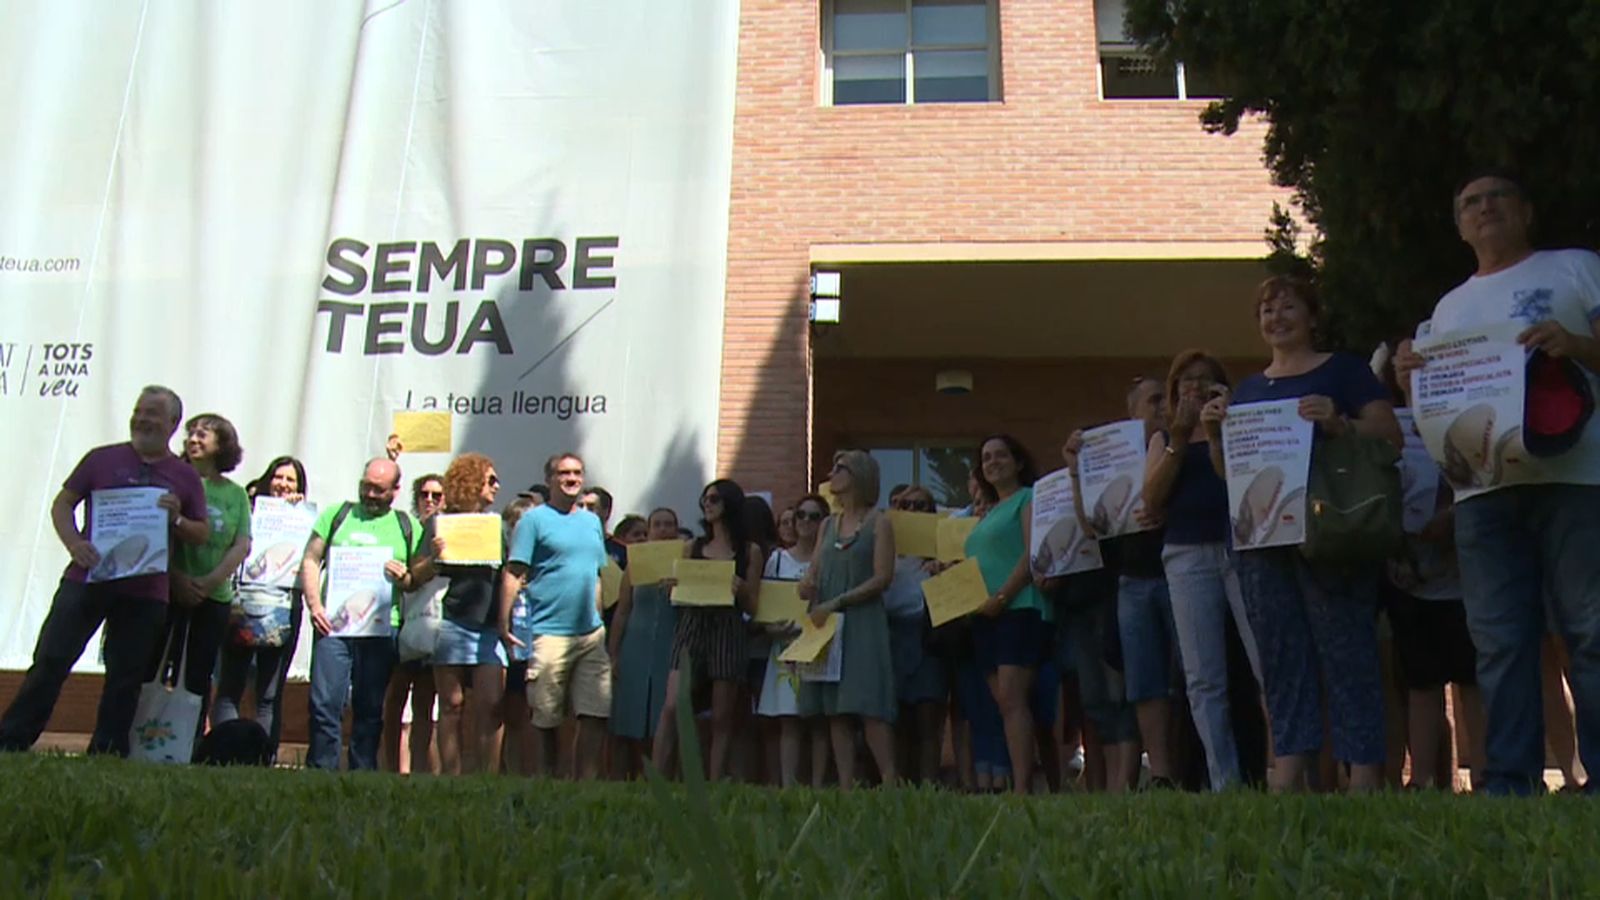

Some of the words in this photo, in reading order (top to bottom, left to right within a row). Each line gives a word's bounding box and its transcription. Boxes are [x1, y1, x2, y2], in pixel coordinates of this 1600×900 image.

[322, 236, 619, 296] SEMPRE
[317, 300, 514, 356] TEUA
[43, 343, 93, 361] TOTS
[39, 363, 49, 376] A
[54, 363, 88, 377] UNA
[39, 378, 79, 397] veu
[448, 393, 503, 414] teua
[511, 391, 607, 420] llengua
